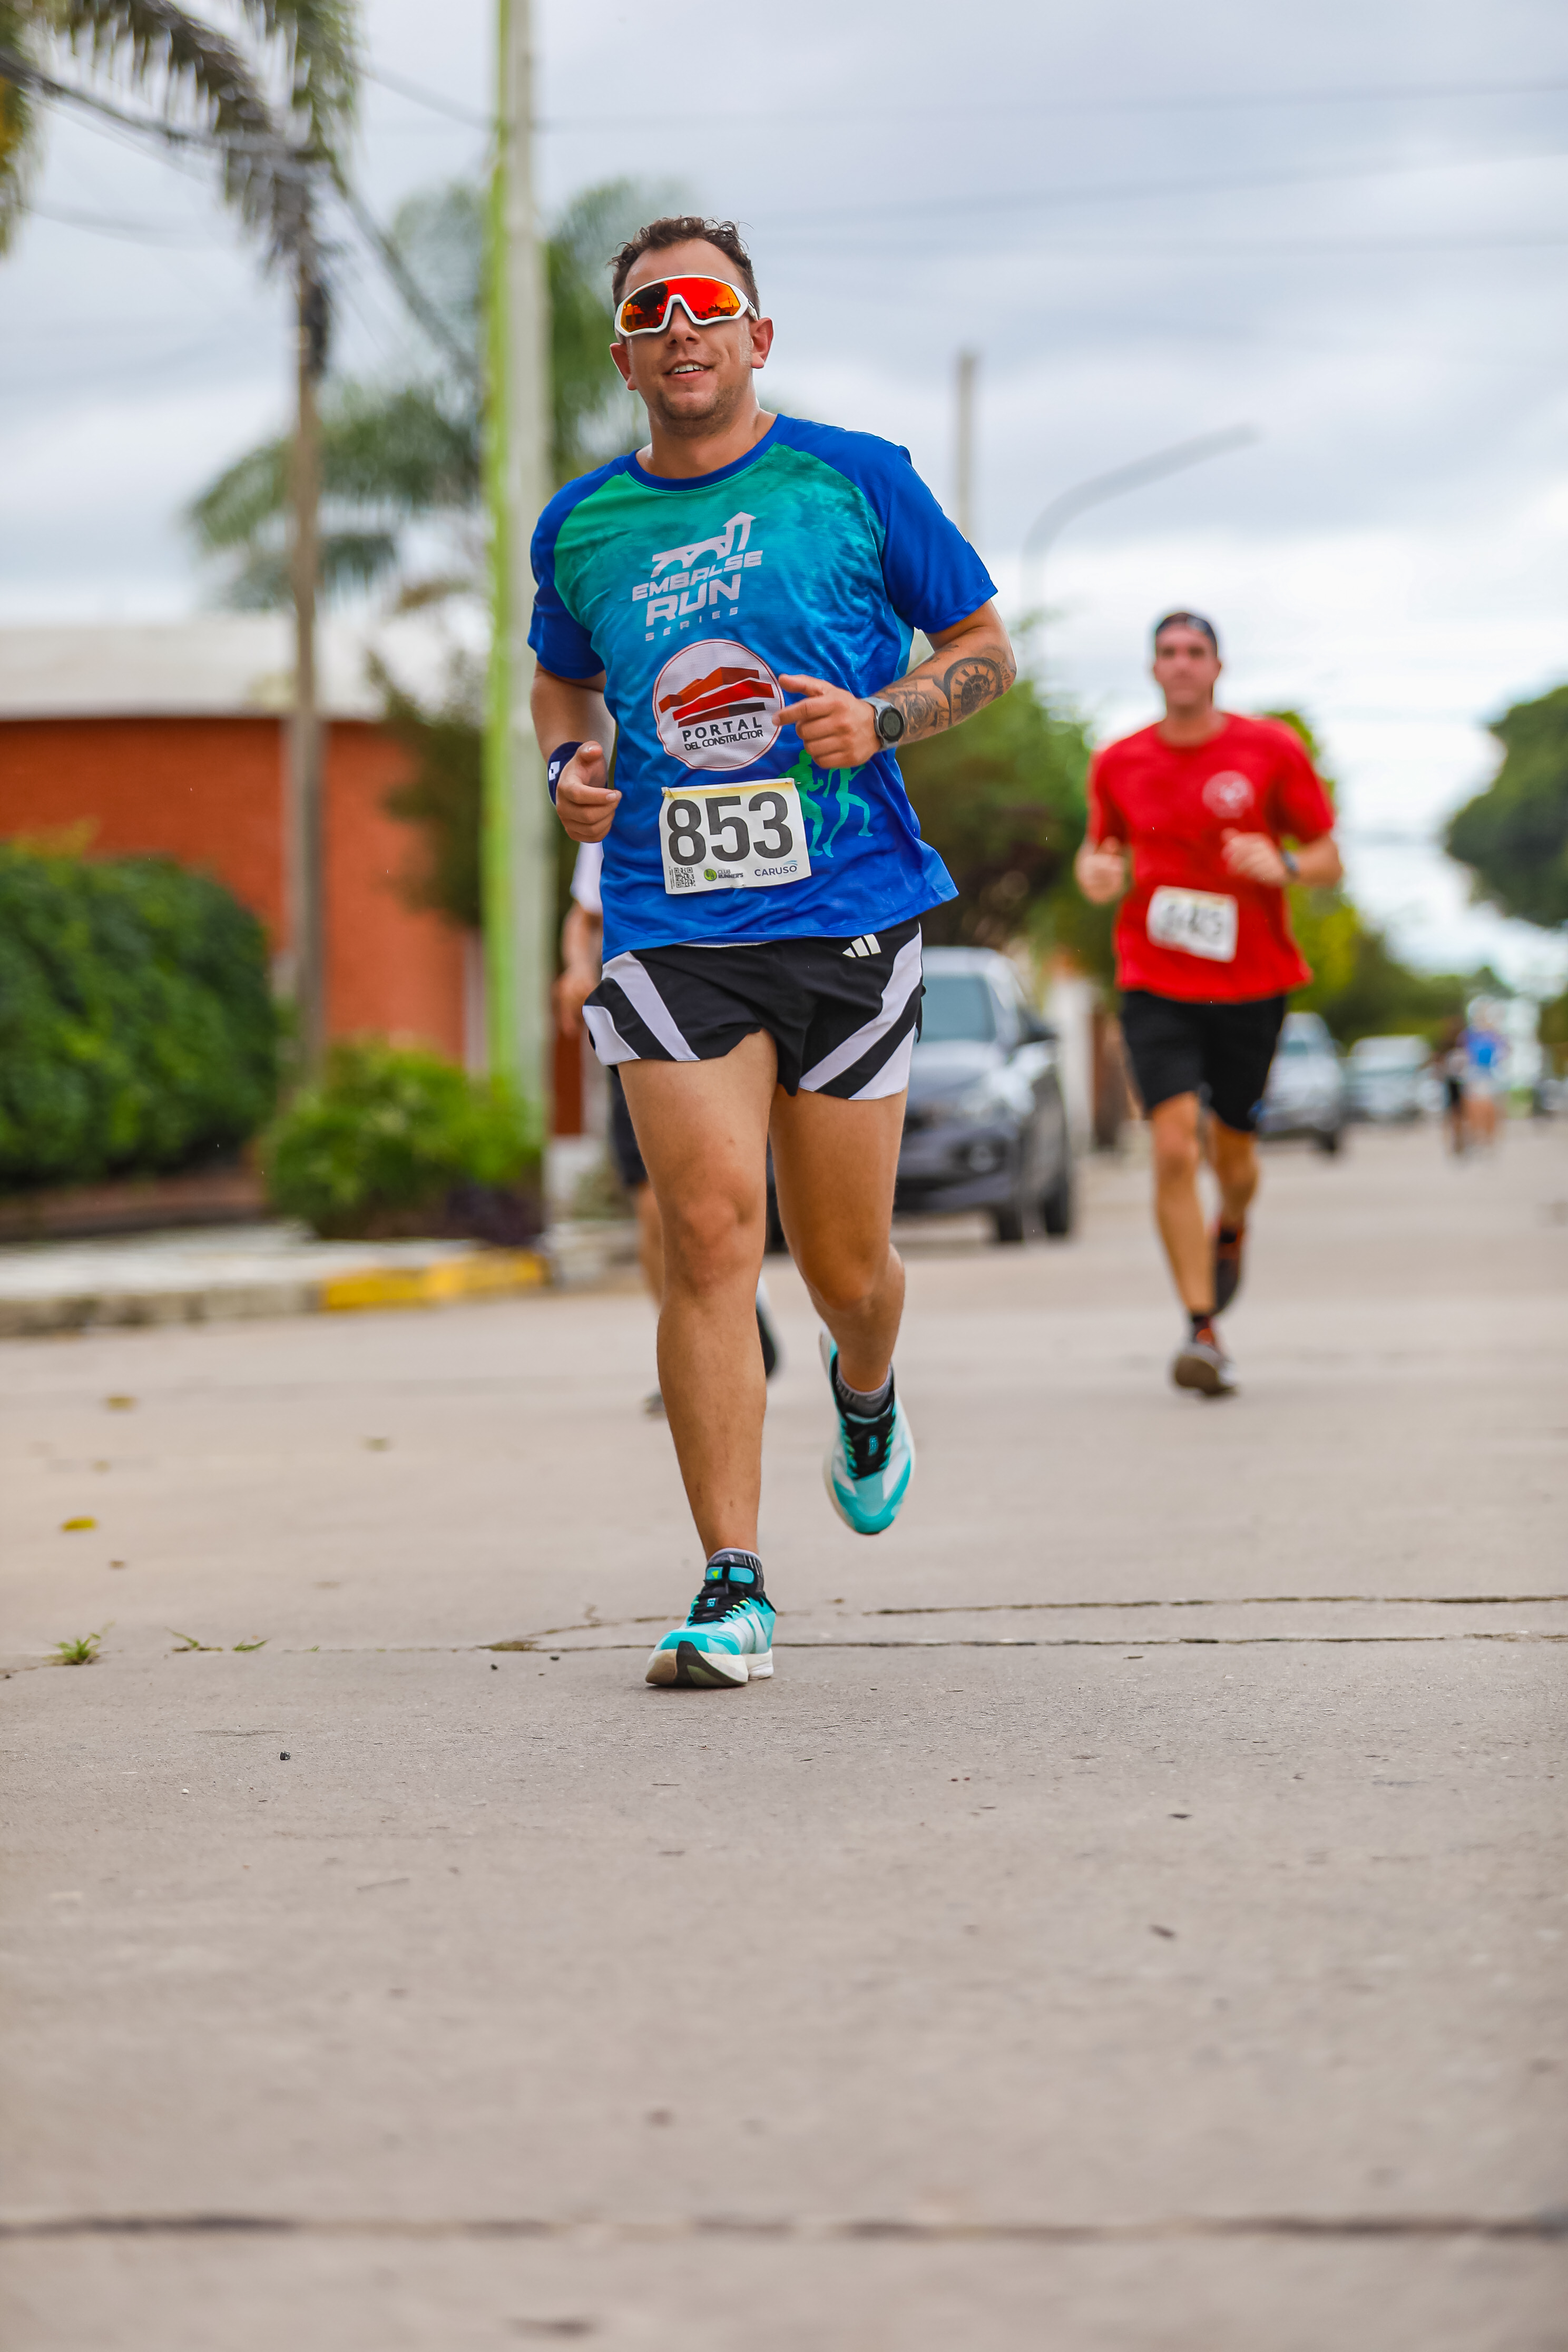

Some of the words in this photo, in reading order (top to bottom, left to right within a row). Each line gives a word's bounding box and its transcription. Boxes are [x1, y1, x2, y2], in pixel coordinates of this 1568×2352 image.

[632, 550, 763, 602] EMBALSE
[645, 573, 741, 627] RUN
[645, 607, 738, 642] SERIES
[682, 717, 762, 742] PORTAL
[684, 741, 701, 751] DEL
[702, 729, 763, 748] CONSTRUCTOR
[667, 791, 793, 866] 853
[754, 865, 798, 877] CARUSO
